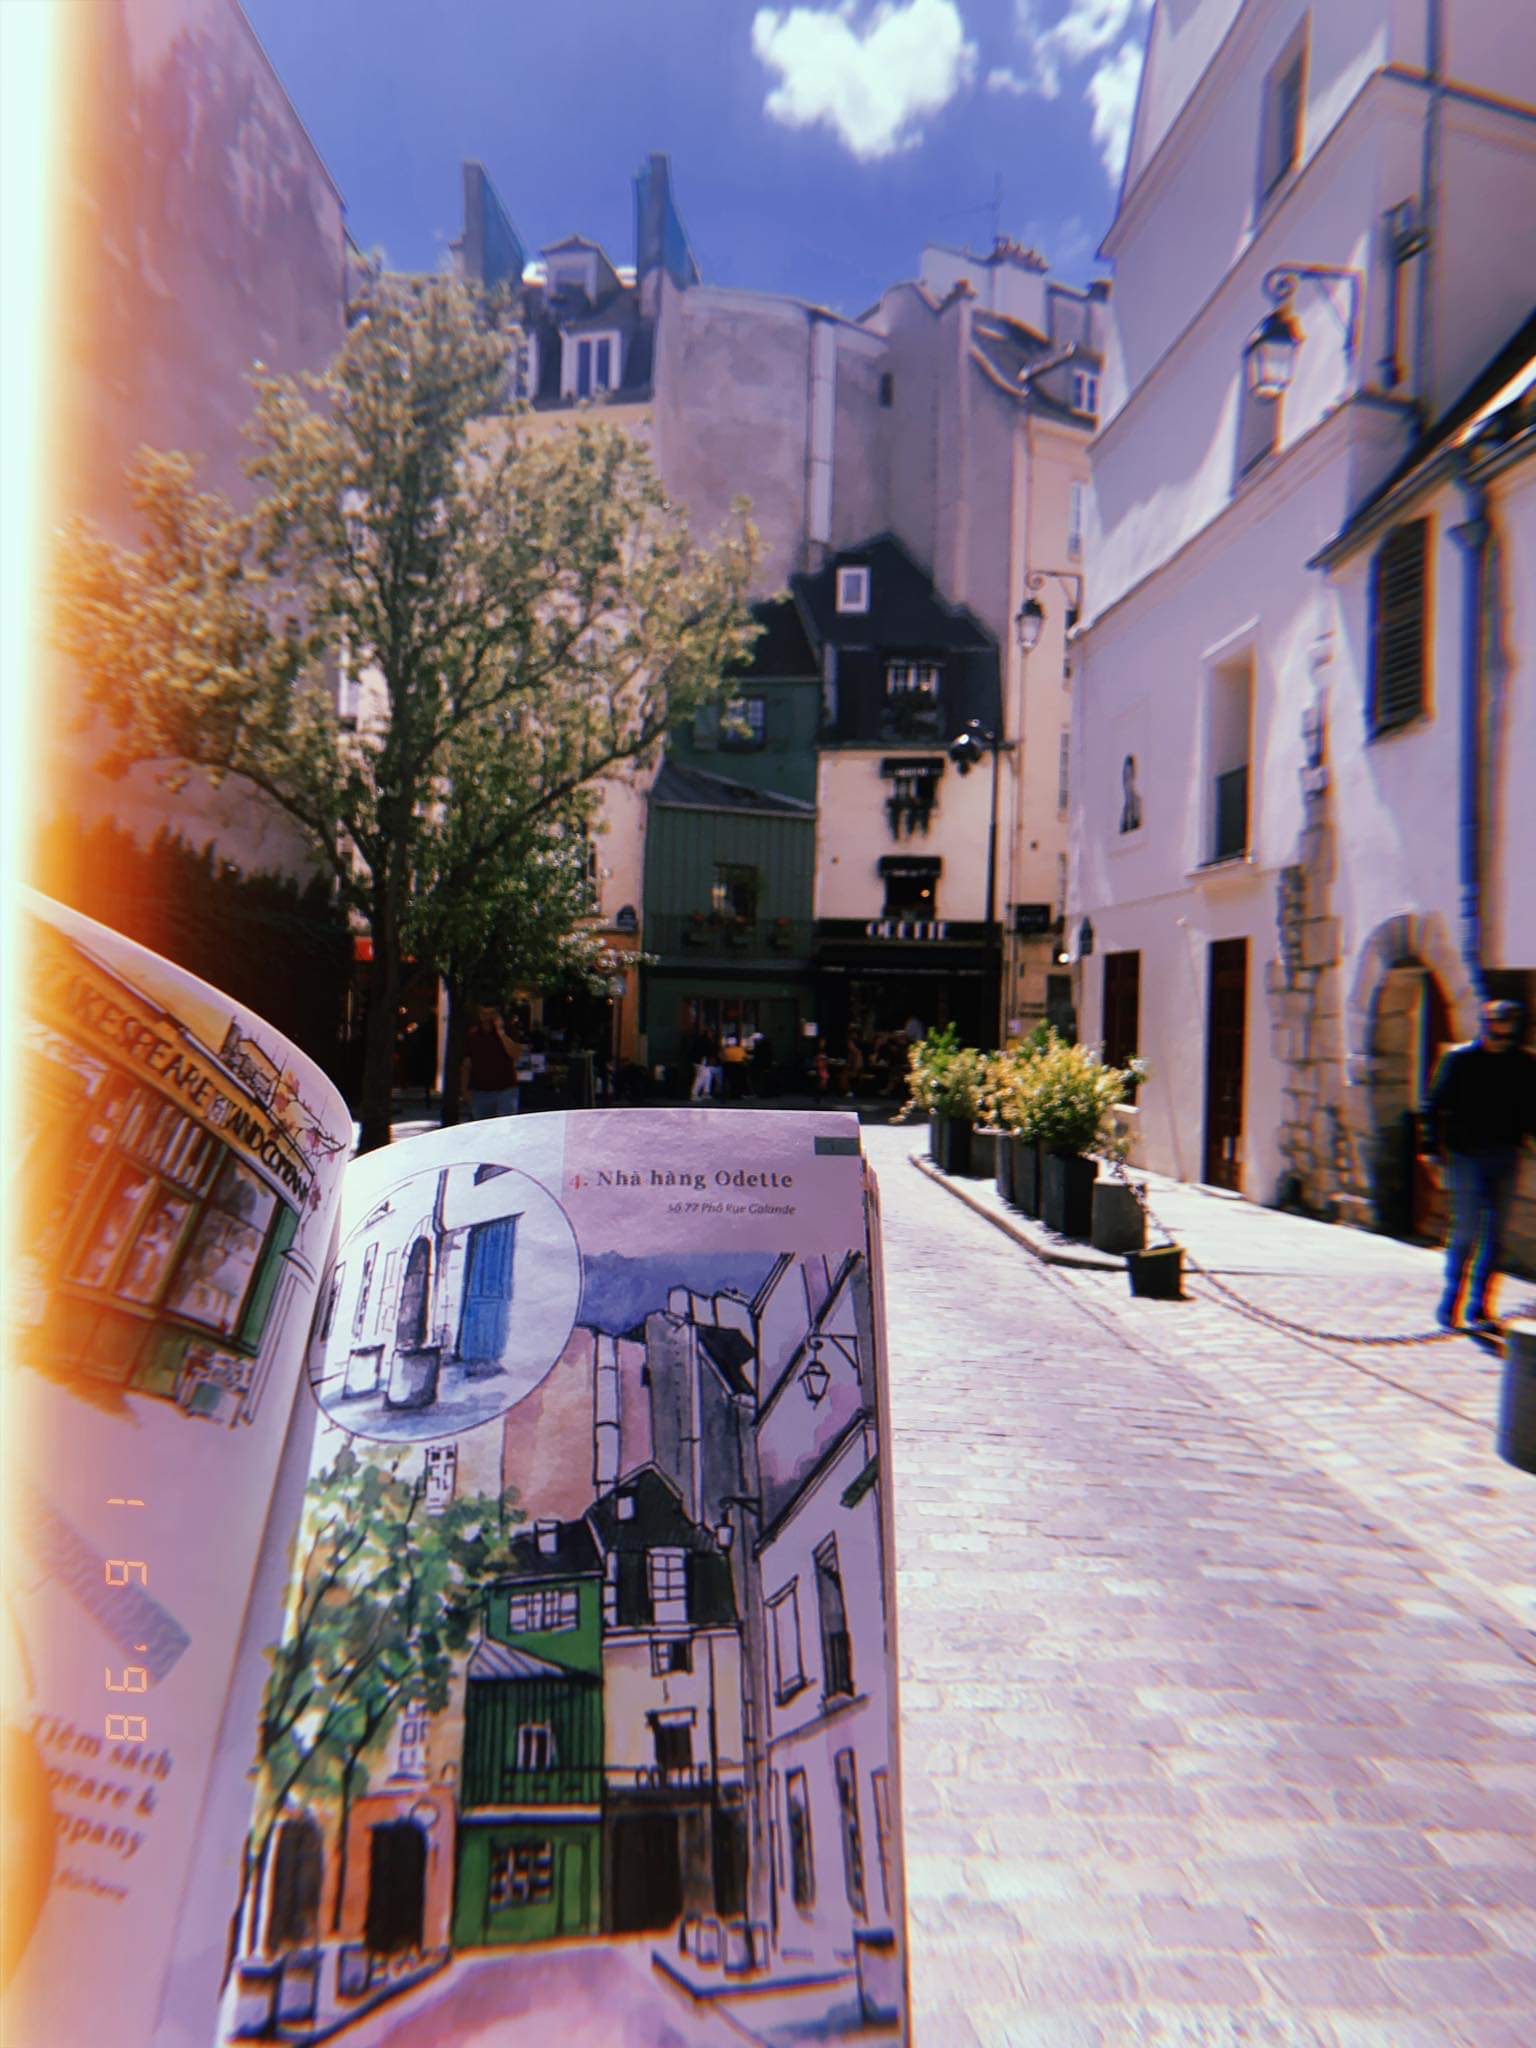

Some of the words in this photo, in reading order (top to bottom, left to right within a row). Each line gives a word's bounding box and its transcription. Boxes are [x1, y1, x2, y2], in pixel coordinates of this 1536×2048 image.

[72, 981, 213, 1106] KESPEARE
[597, 1169, 641, 1187] Nhà
[650, 1169, 707, 1190] hàng
[714, 1169, 793, 1188] Odette
[683, 1202, 700, 1213] 77
[748, 1202, 797, 1216] Galande
